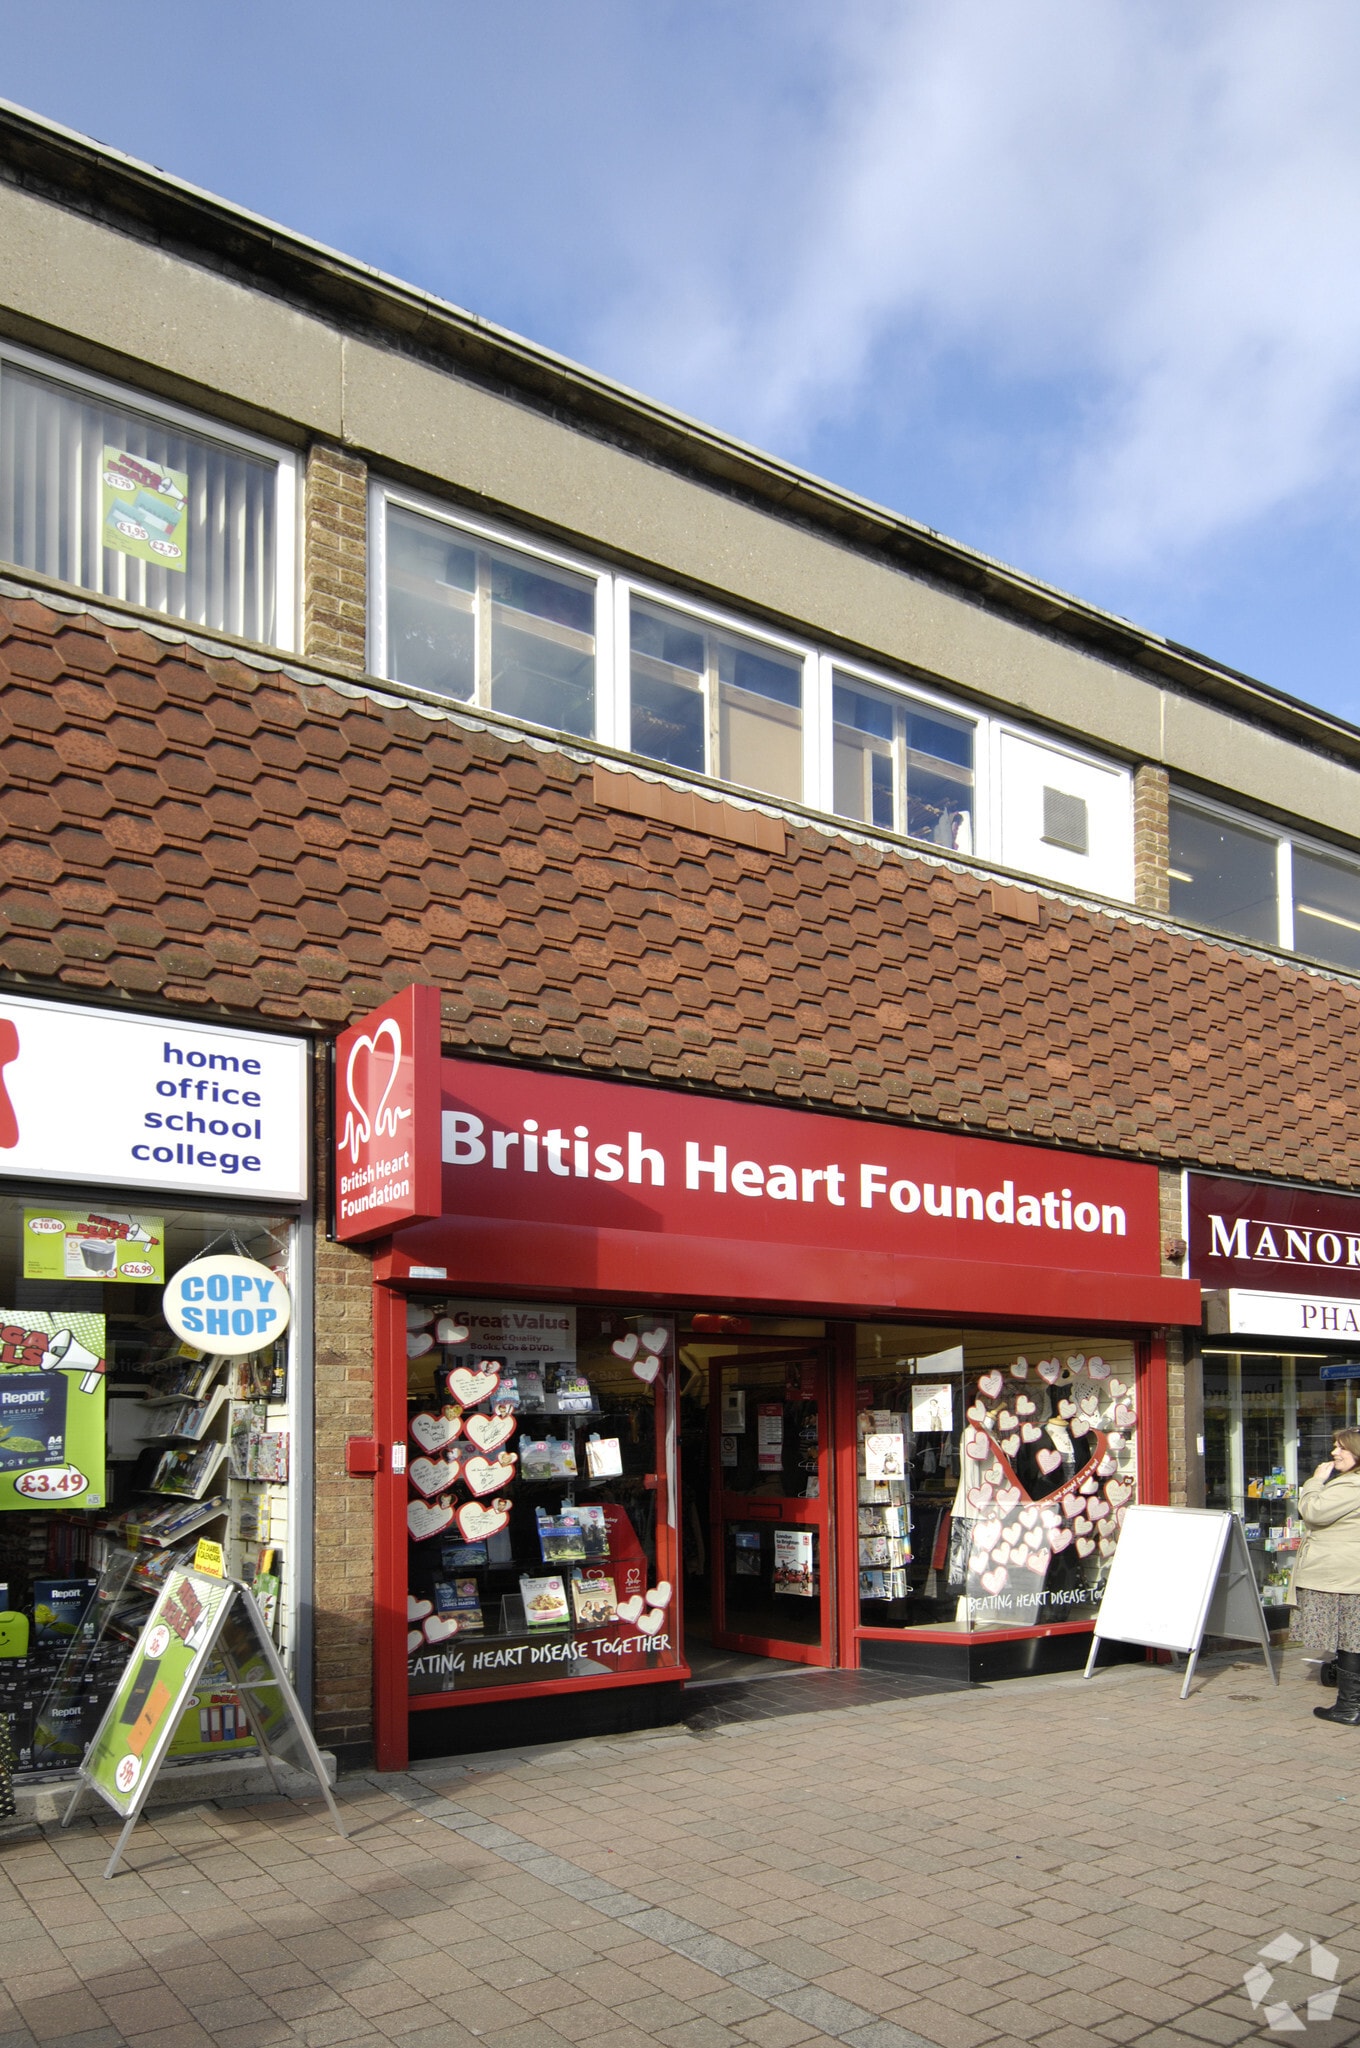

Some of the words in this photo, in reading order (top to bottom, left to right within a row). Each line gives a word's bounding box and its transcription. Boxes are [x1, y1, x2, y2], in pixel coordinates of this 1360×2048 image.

[119, 522, 147, 539] £1.95
[152, 541, 179, 556] £2.79
[163, 1042, 262, 1076] home
[155, 1077, 262, 1108] office
[144, 1109, 262, 1140] school
[131, 1143, 262, 1174] college
[341, 1164, 375, 1195] British
[375, 1151, 409, 1180] Heart
[441, 1110, 665, 1187] British
[685, 1141, 845, 1206] Heart
[860, 1163, 1126, 1236] Foundation
[341, 1179, 409, 1219] Foundation
[32, 1222, 62, 1230] £10.00
[77, 1223, 128, 1239] DEALS
[123, 1264, 152, 1275] £26.99
[181, 1274, 275, 1303] COPY
[181, 1307, 277, 1336] SHOP
[455, 1311, 511, 1329] Great
[512, 1313, 570, 1330] Value
[0, 1322, 49, 1352] GA
[483, 1333, 508, 1342] Good
[509, 1334, 542, 1343] Quality
[470, 1342, 501, 1352] Books,
[502, 1343, 519, 1352] CDs
[520, 1343, 528, 1351] &
[529, 1343, 554, 1352] DVDs
[2, 1391, 45, 1405] Report
[48, 1435, 63, 1444] A4
[20, 1473, 84, 1493] £3.49
[51, 1589, 81, 1599] Report
[969, 1593, 1012, 1612] BEATING
[1016, 1590, 1050, 1608] HEART
[1051, 1587, 1085, 1605] DISEASE
[472, 1645, 529, 1670] HEART
[530, 1641, 589, 1664] DISEASE
[591, 1633, 672, 1656] TOGETHER
[51, 1706, 82, 1717] Report
[19, 1747, 31, 1755] A4
